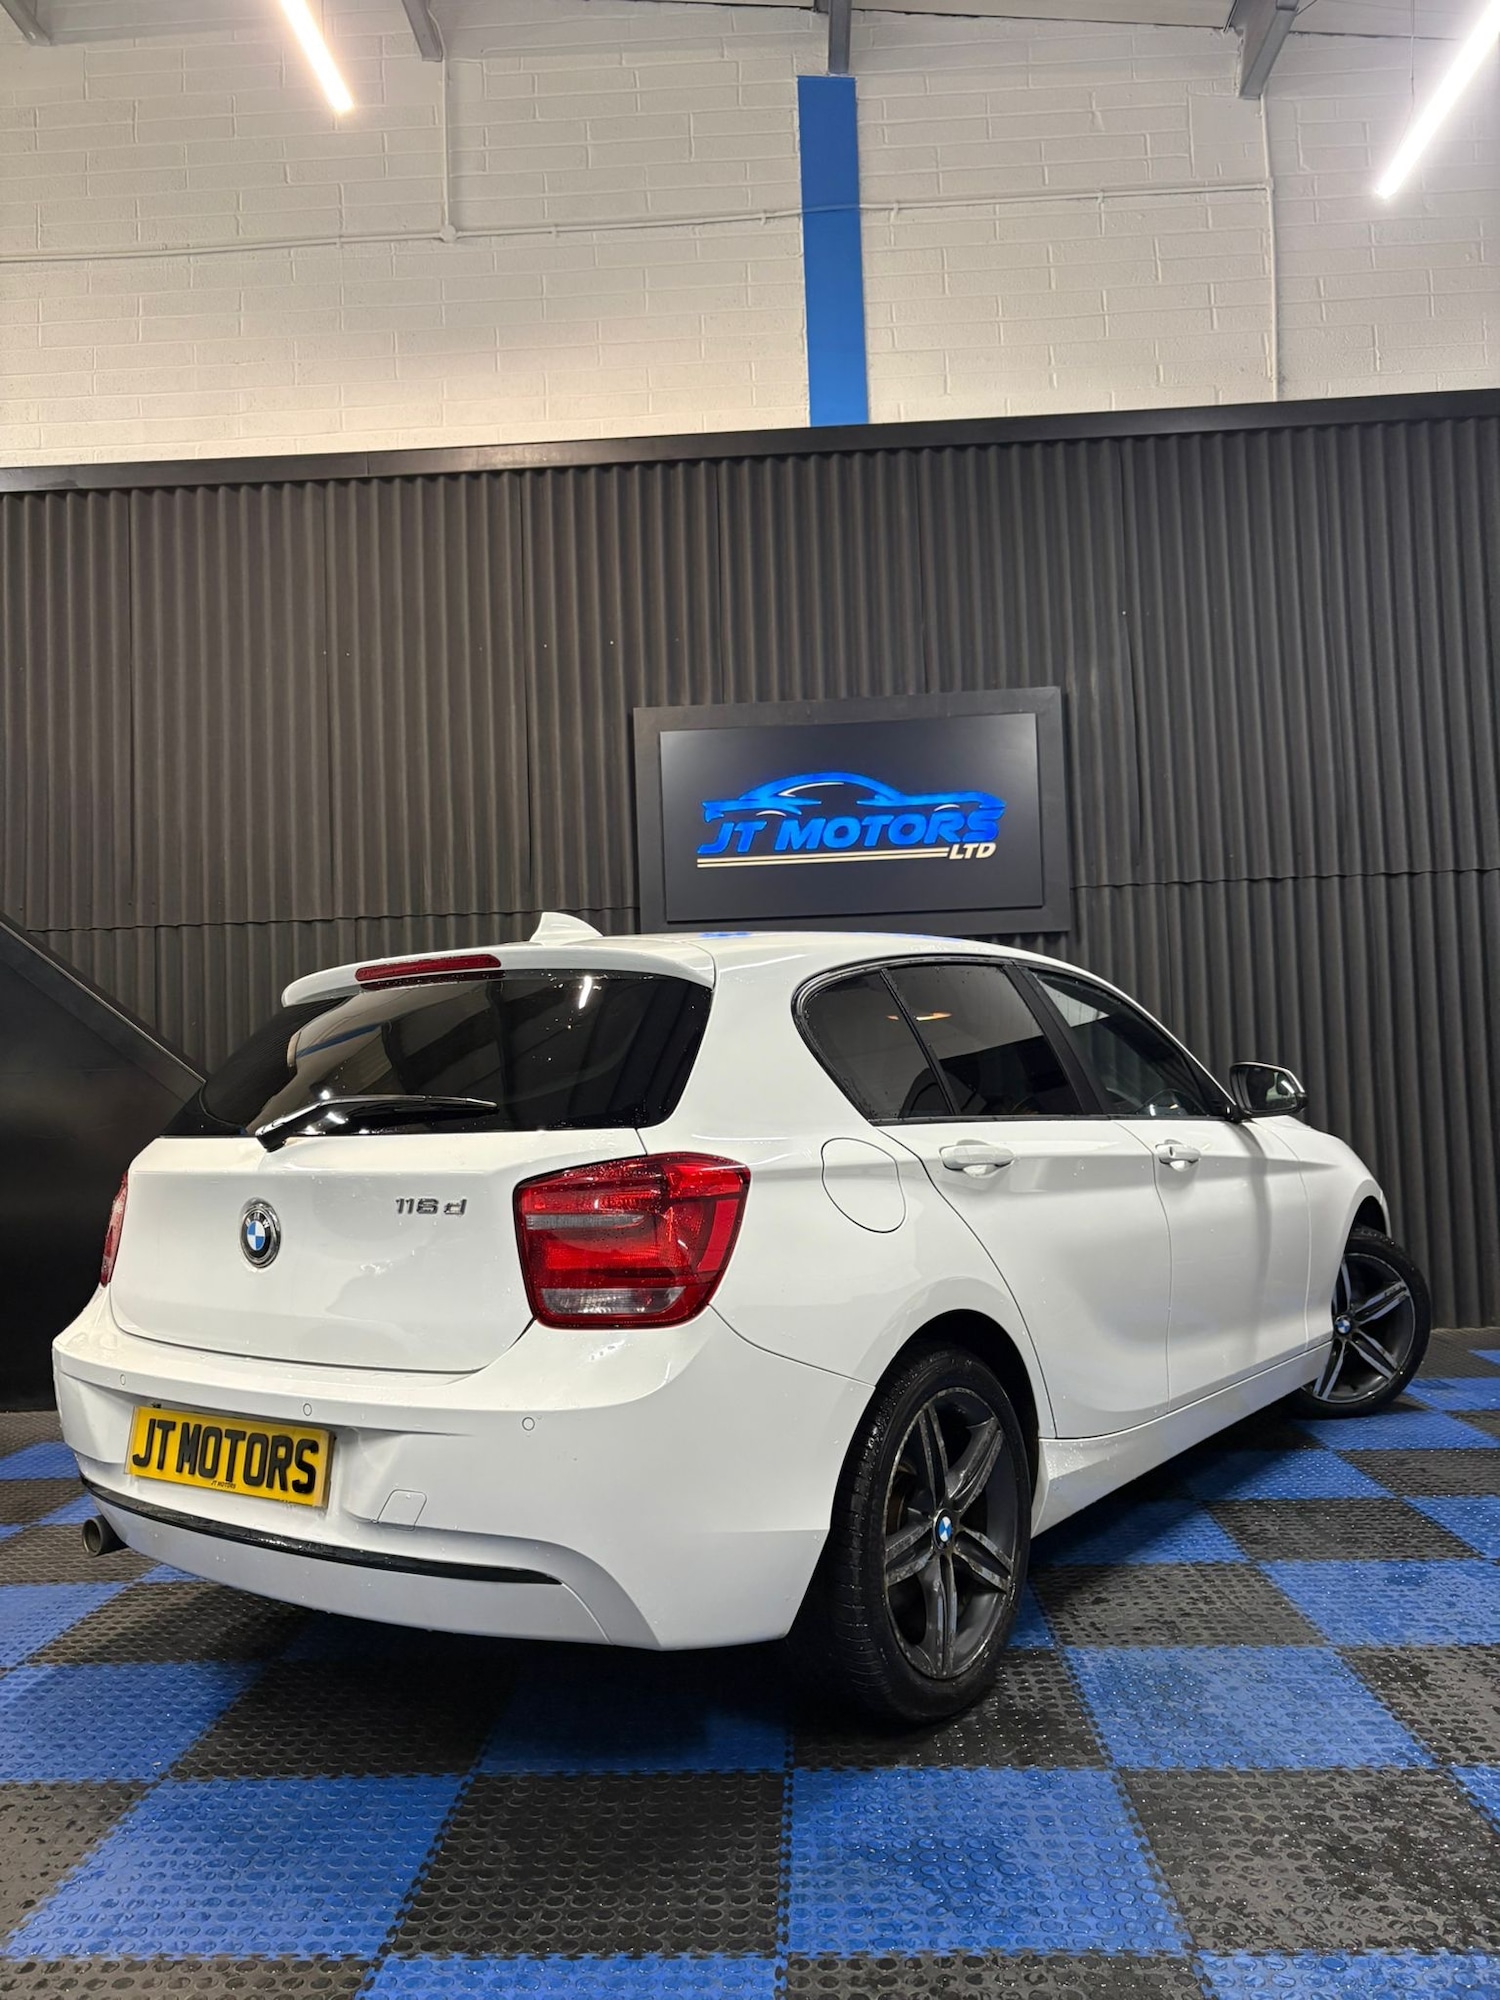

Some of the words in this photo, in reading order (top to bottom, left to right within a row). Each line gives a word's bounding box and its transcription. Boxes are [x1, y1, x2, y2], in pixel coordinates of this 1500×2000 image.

[697, 821, 768, 854] JT
[774, 806, 1005, 850] MOTORS
[949, 842, 996, 860] LTD
[132, 1418, 176, 1470] JT
[175, 1422, 319, 1494] MOTORS
